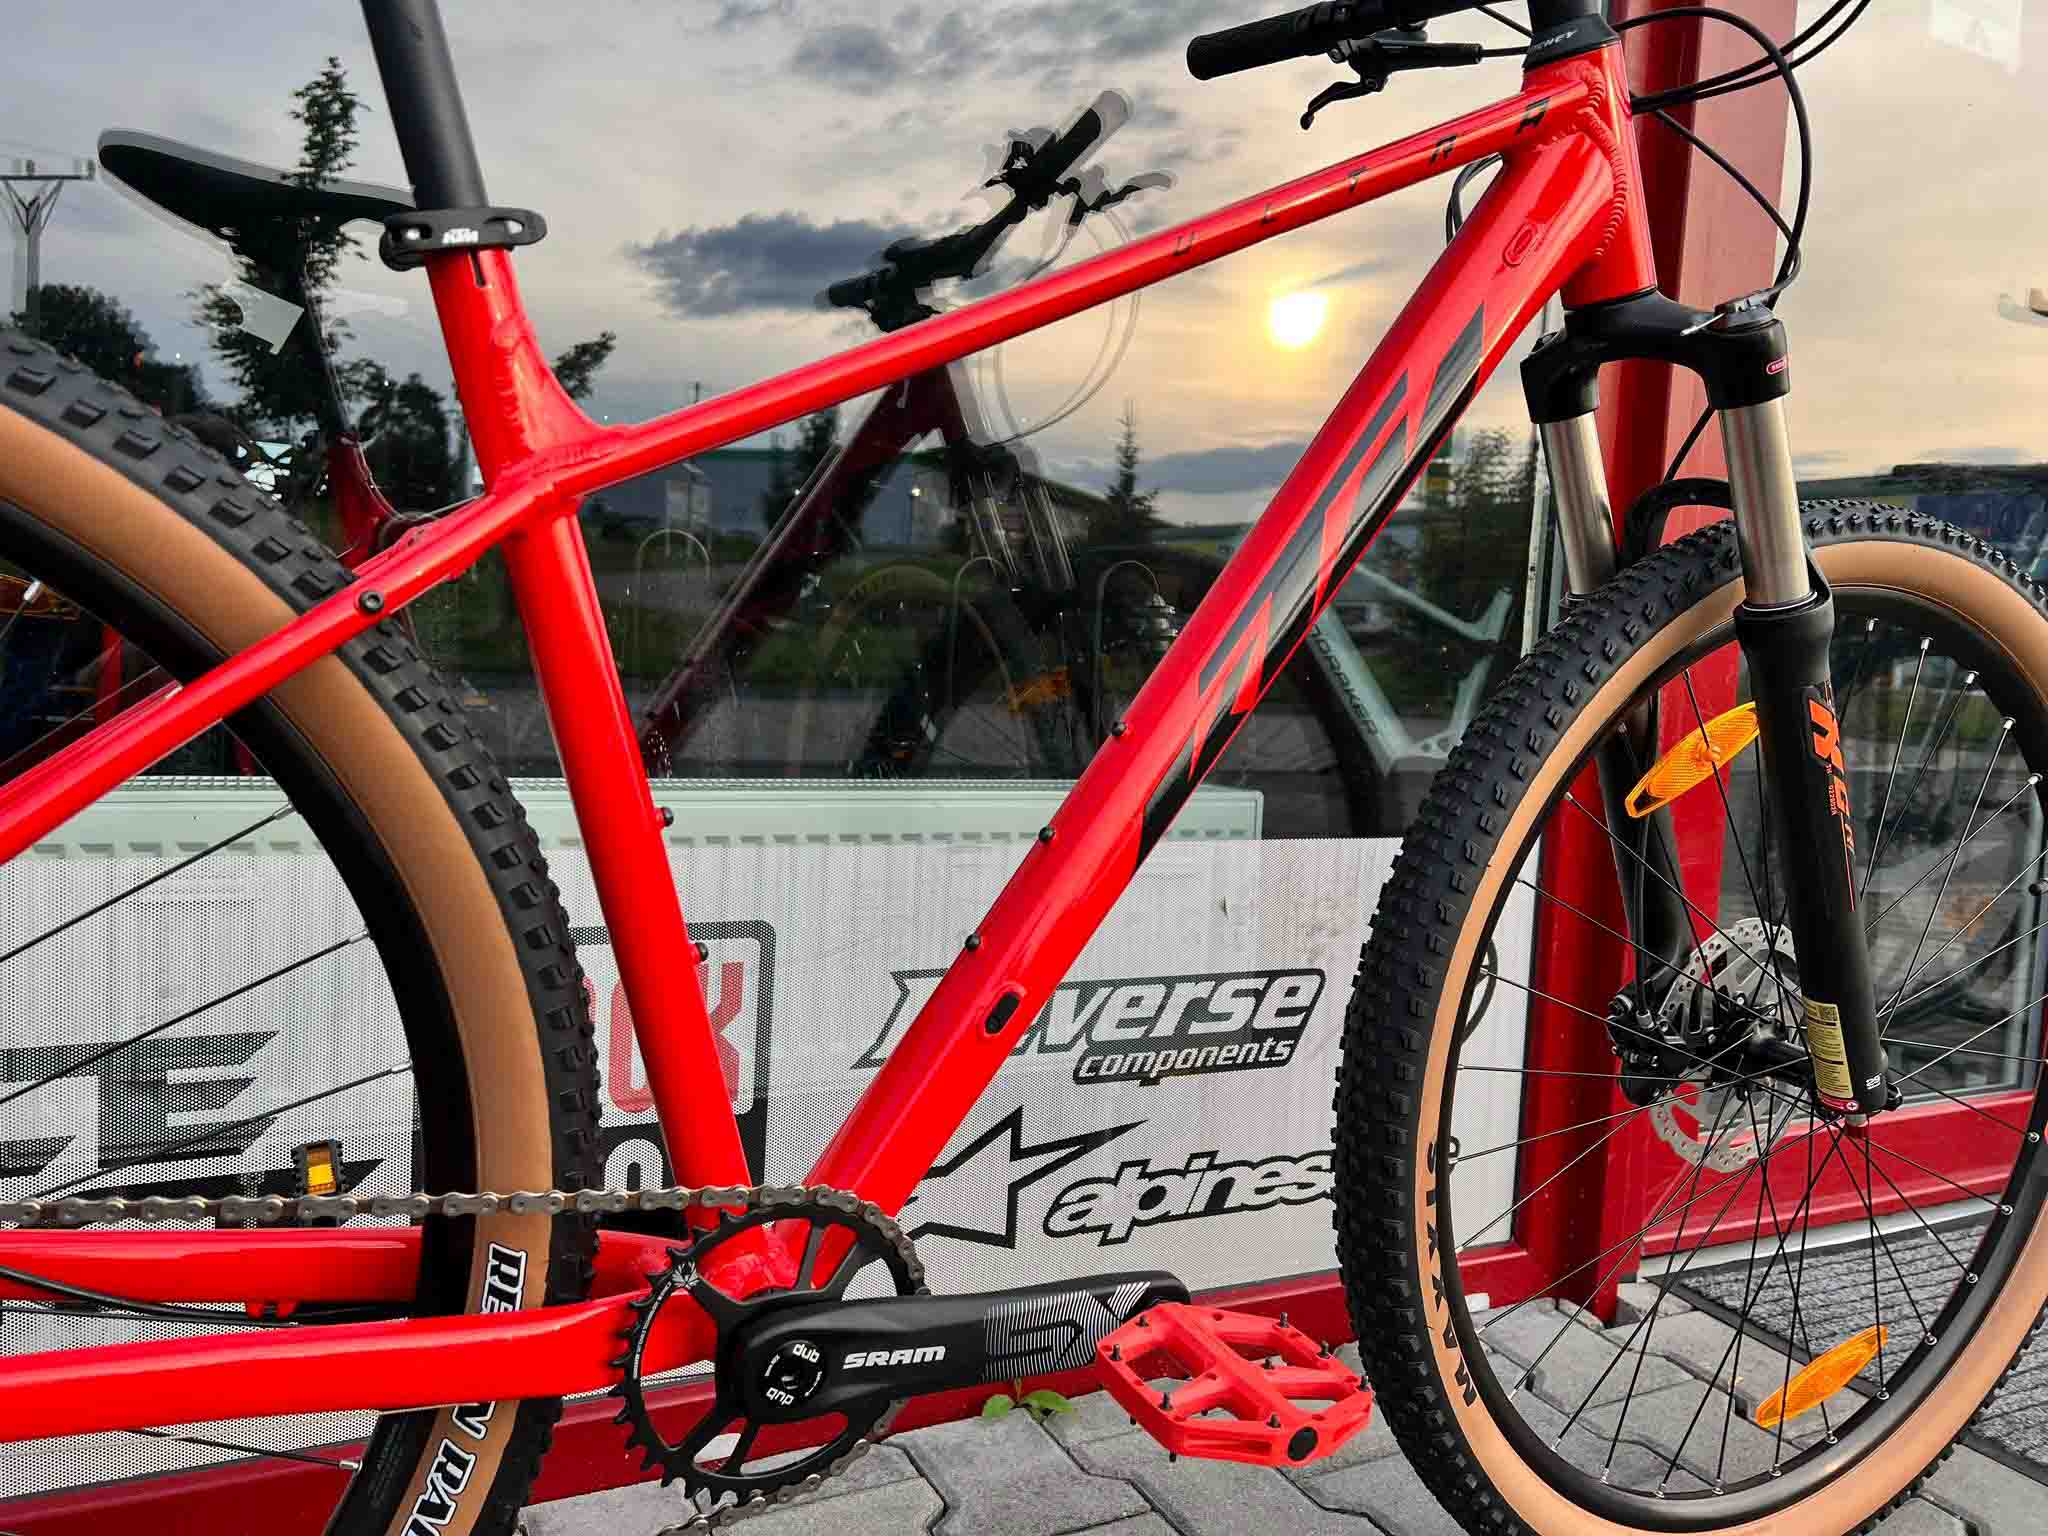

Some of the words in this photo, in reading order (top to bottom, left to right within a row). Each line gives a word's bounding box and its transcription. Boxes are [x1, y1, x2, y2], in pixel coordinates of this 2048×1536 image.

[1078, 1036, 1297, 1084] components
[1044, 1149, 1338, 1248] alpines
[1424, 1141, 1479, 1408] MAXXIS
[792, 1343, 820, 1363] dub
[842, 1345, 946, 1370] SRAM
[766, 1386, 795, 1406] dub
